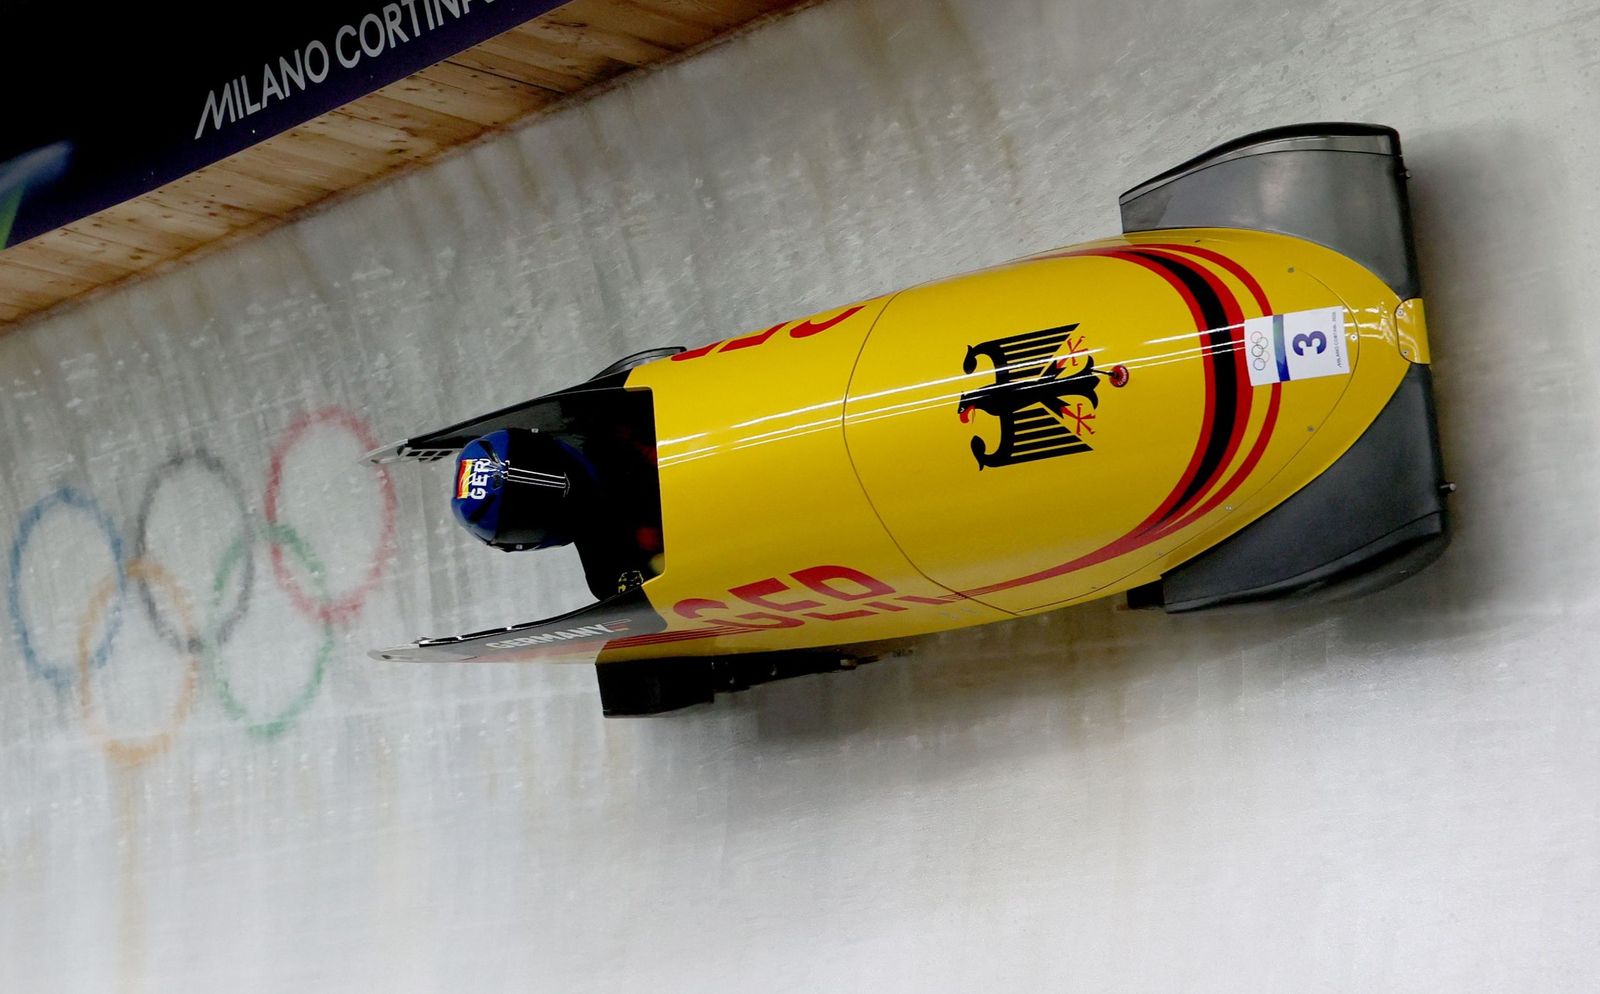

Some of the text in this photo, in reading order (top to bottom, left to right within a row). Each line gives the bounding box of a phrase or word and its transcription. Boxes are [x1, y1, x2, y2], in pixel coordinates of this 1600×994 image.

[194, 0, 496, 140] MILANO CORTIN
[1292, 330, 1327, 356] 3
[469, 458, 491, 500] GER
[485, 624, 615, 651] GERMANY
